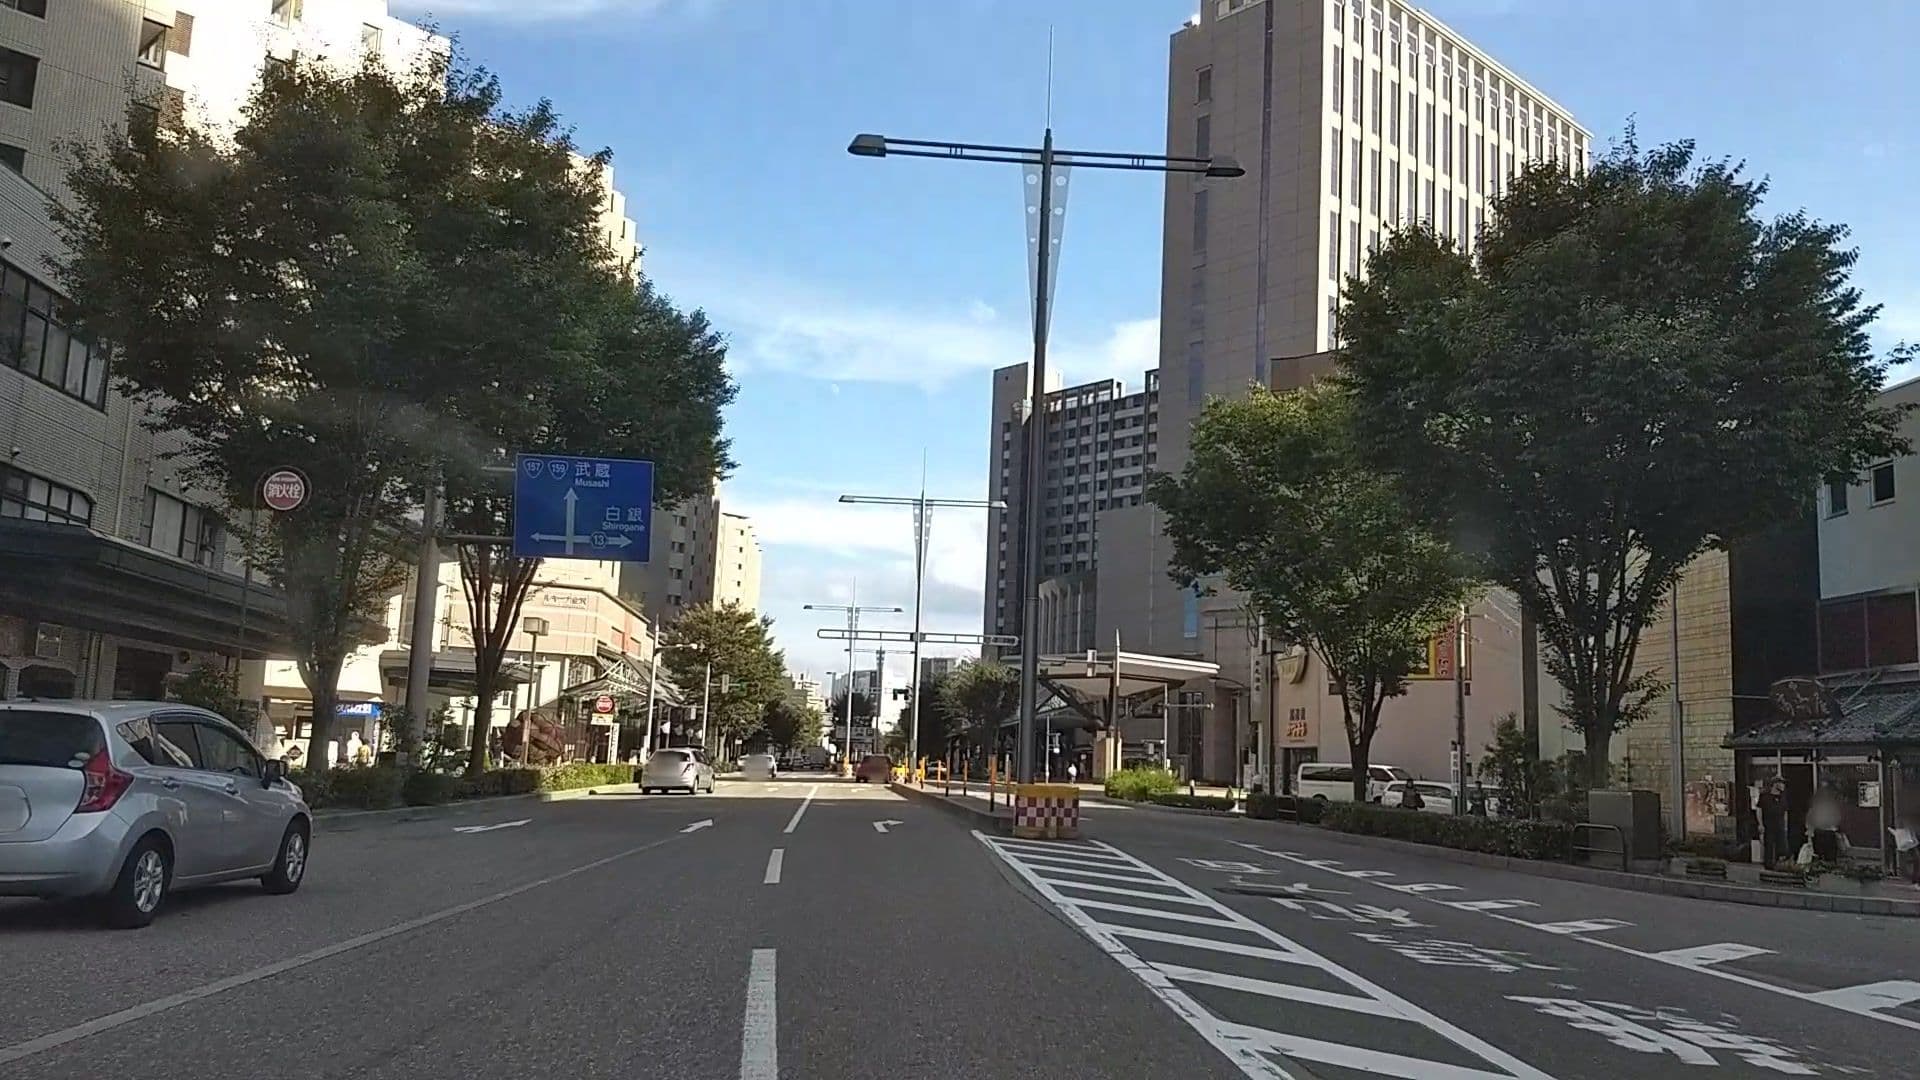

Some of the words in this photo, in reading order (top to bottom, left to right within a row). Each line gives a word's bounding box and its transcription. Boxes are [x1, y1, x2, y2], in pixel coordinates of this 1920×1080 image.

[526, 462, 541, 471] 157
[551, 463, 566, 473] 159
[575, 461, 611, 478] 武蔵
[574, 478, 610, 488] Musashi
[267, 483, 301, 498] 消火栓
[605, 505, 643, 522] 白銀
[602, 521, 646, 532] Shirogane
[593, 534, 604, 545] 13
